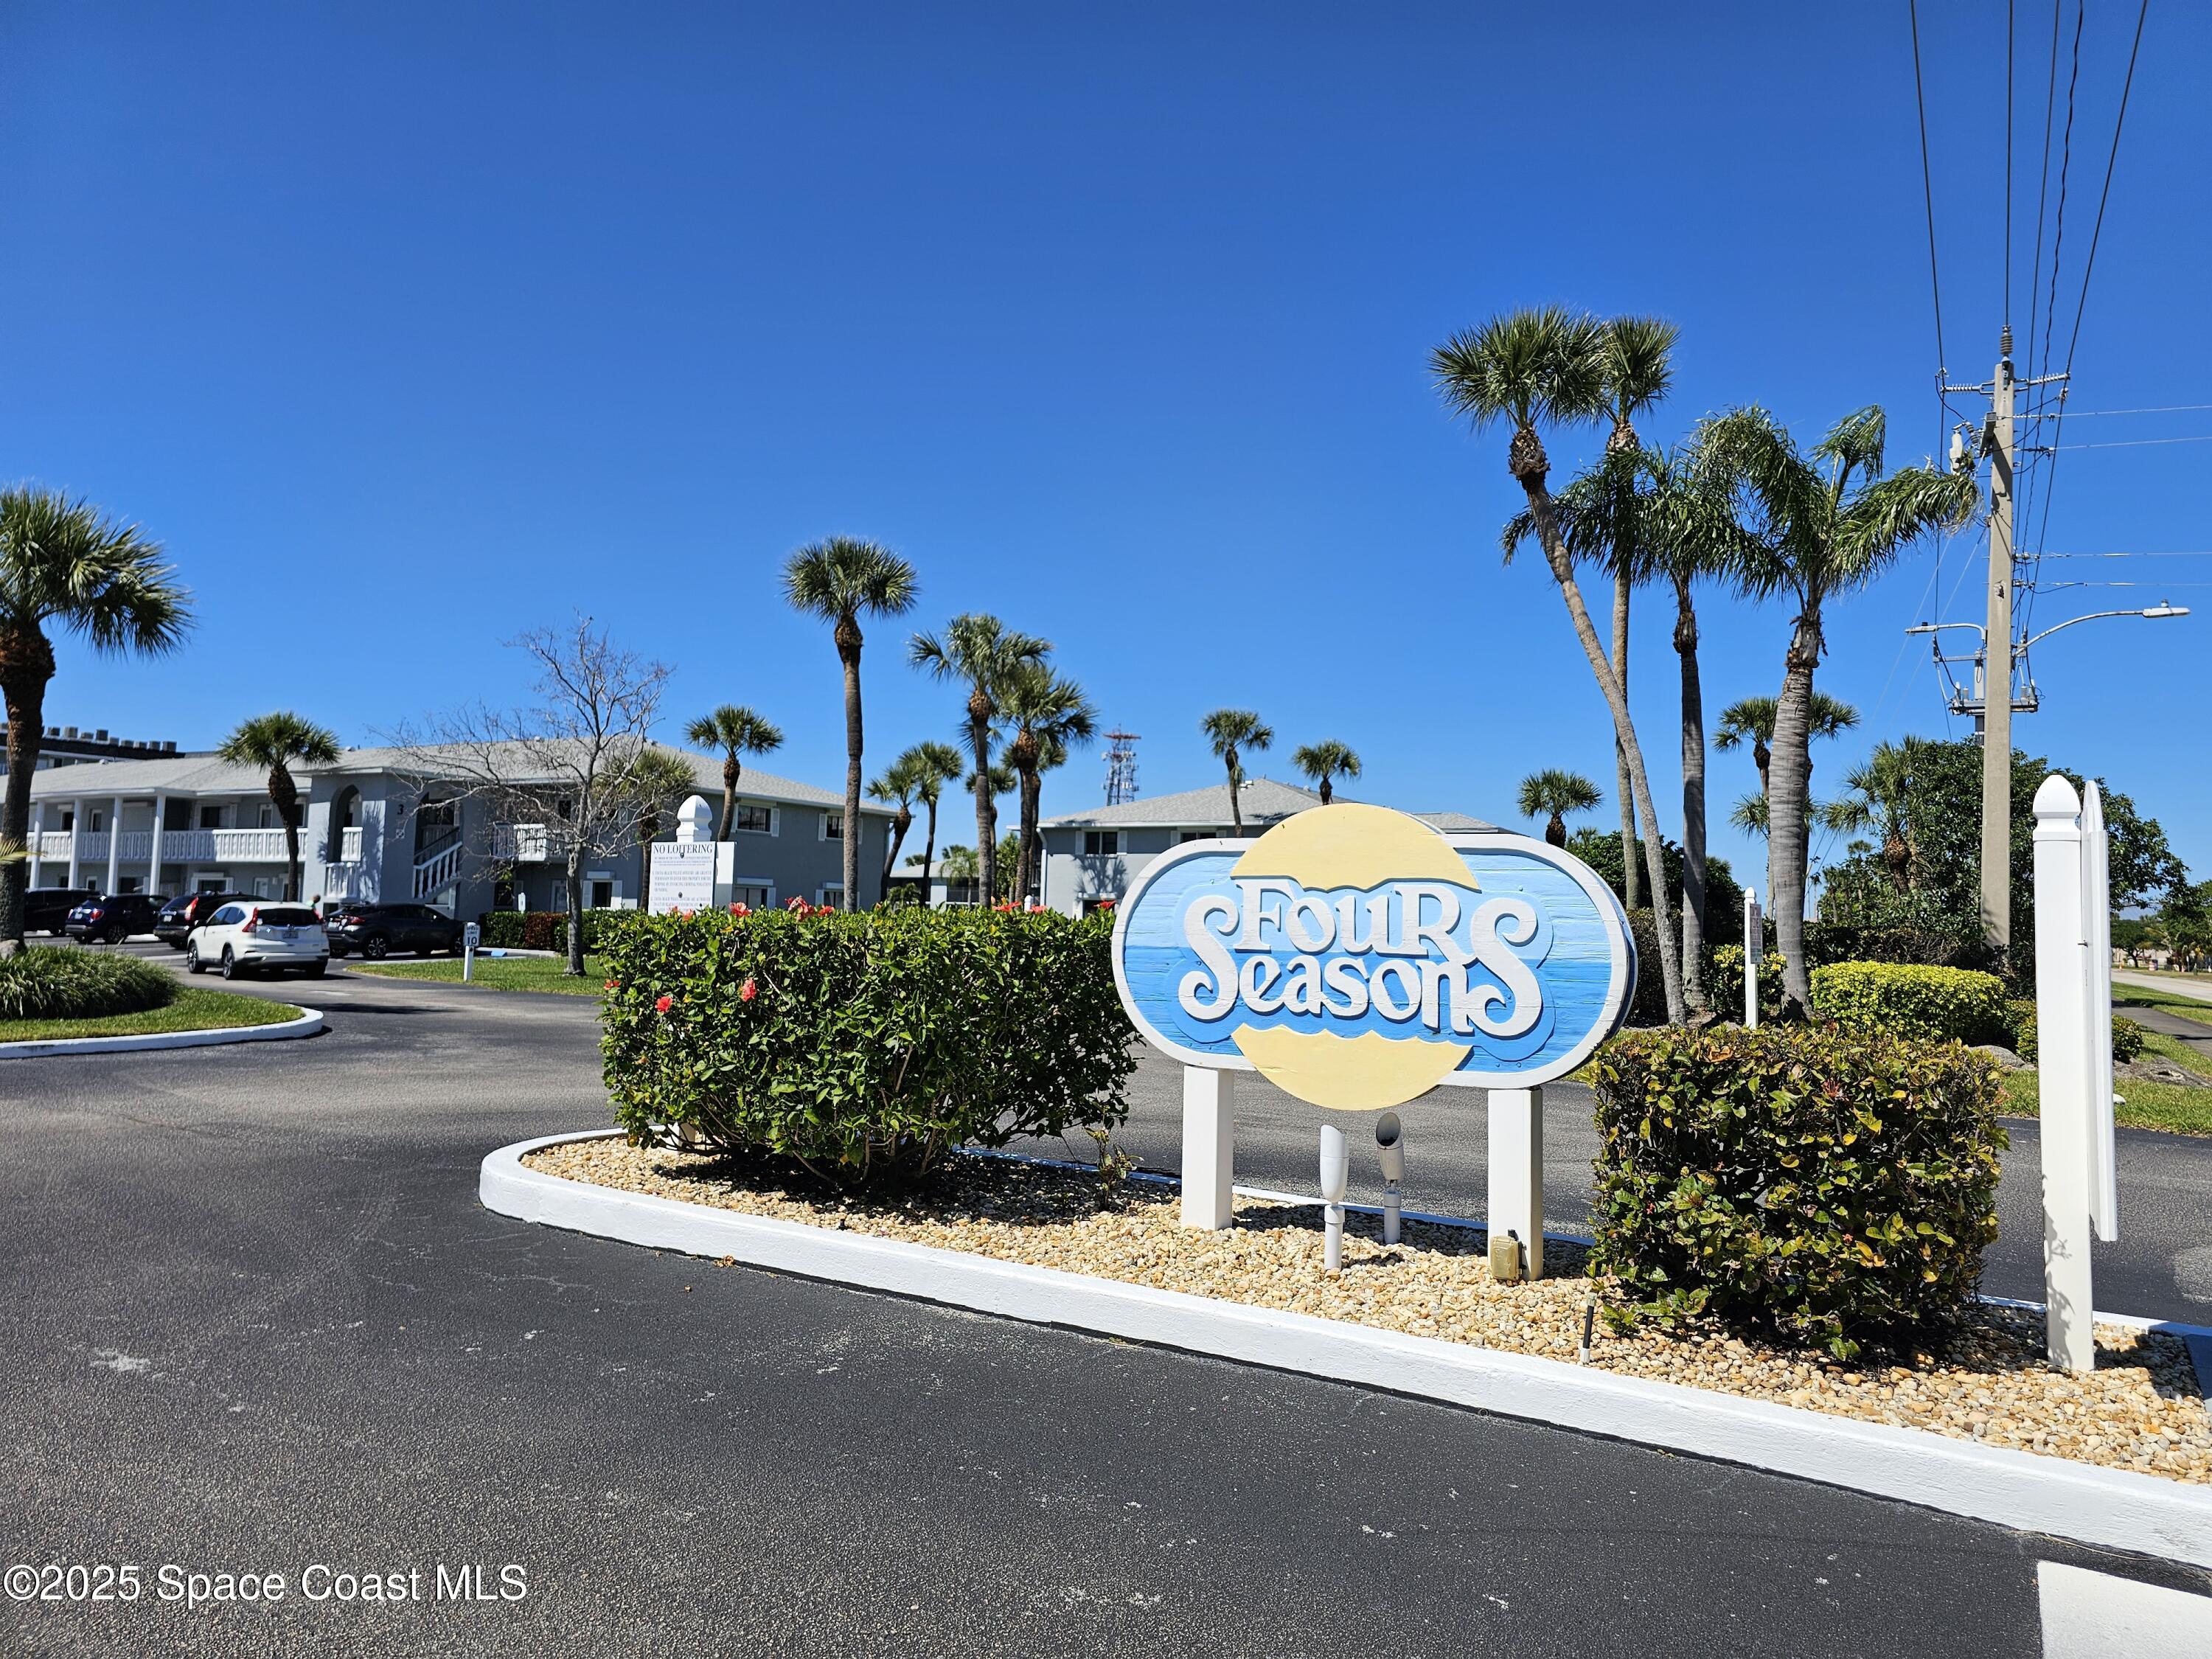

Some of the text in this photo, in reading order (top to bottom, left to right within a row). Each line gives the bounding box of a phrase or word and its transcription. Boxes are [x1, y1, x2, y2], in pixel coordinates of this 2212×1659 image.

[397, 804, 404, 815] 3
[653, 844, 712, 854] NO LOITERING
[467, 936, 477, 945] 10
